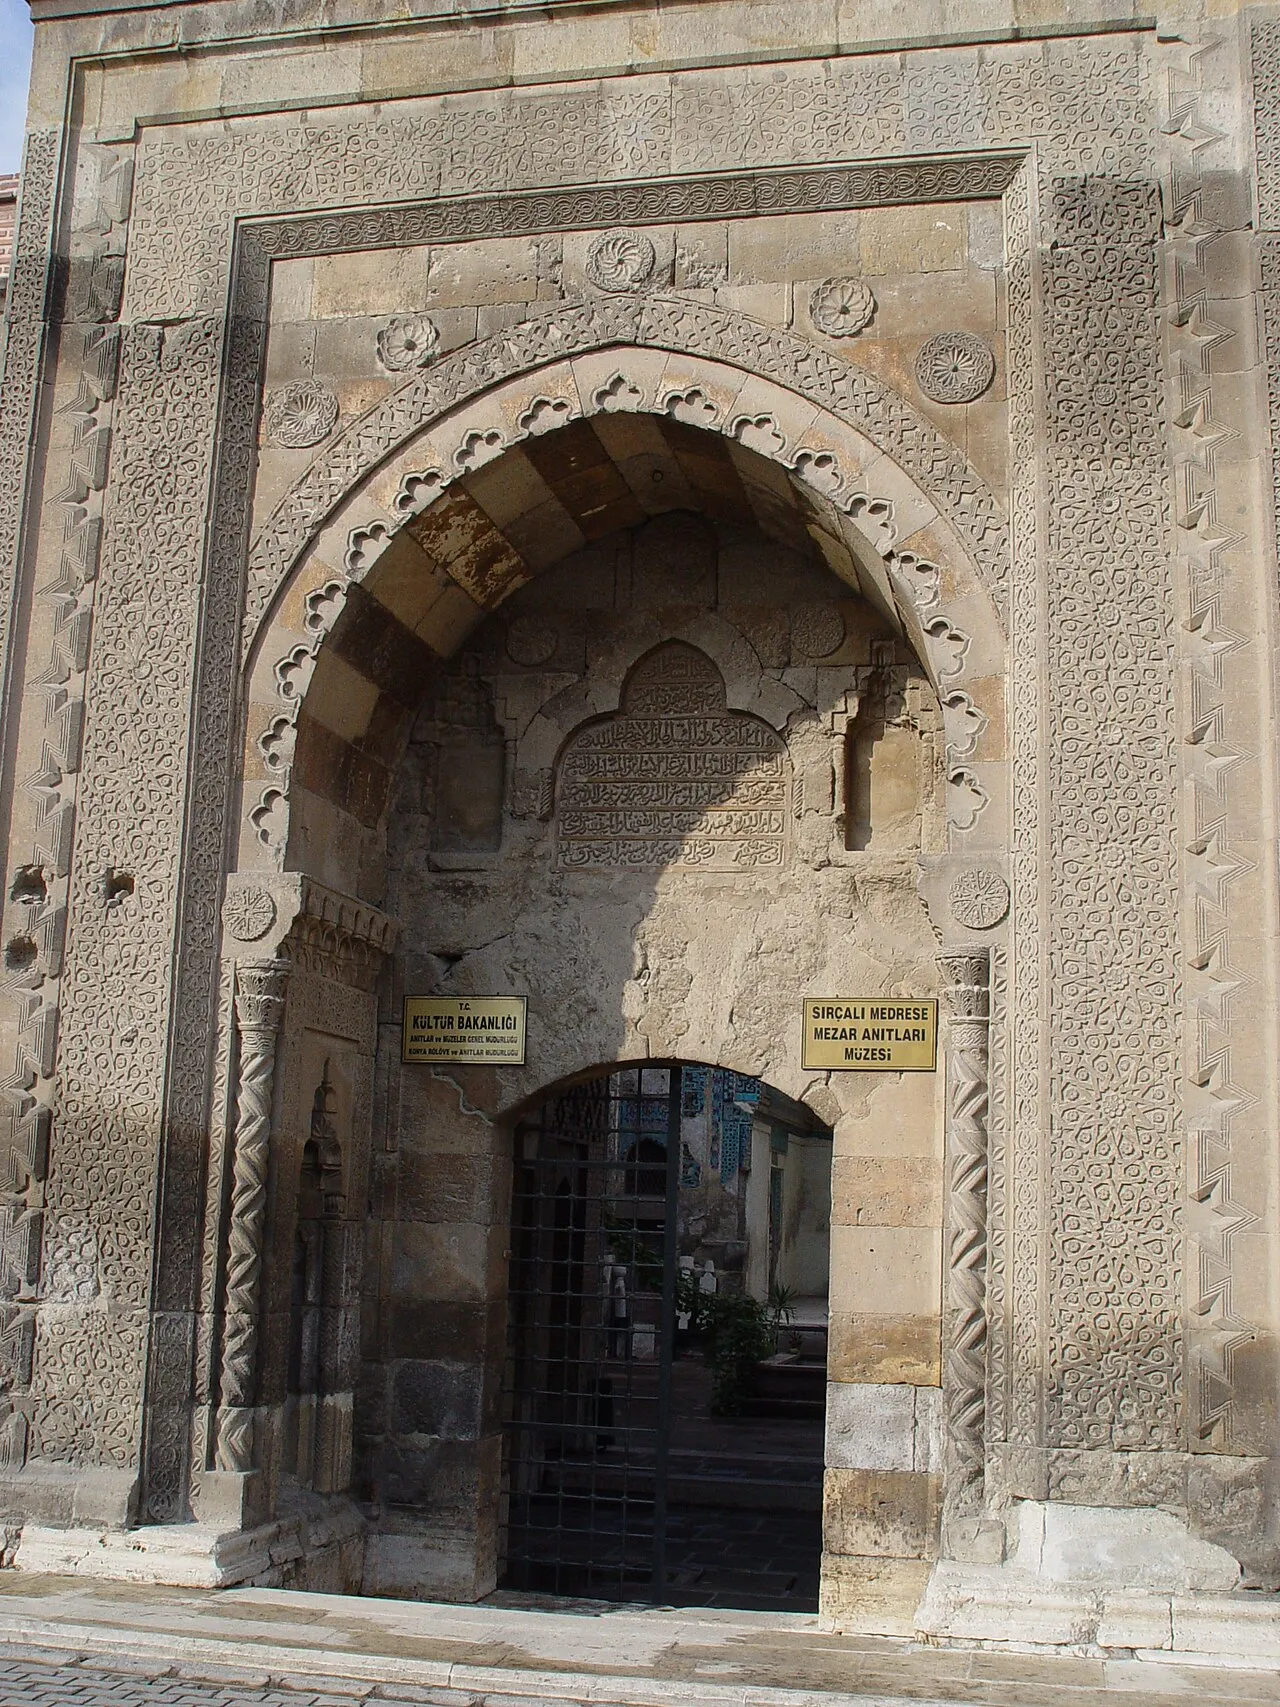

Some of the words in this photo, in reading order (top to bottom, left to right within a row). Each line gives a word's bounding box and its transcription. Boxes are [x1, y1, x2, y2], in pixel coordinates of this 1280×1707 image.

[458, 1003, 471, 1011] T.C.
[812, 1006, 865, 1022] SIRÇALI
[870, 1007, 929, 1021] MEDRESE
[412, 1015, 454, 1030] KÜLTÜR
[457, 1014, 517, 1030] BAKANLIĞI
[814, 1027, 857, 1040] MEZAR
[862, 1028, 926, 1041] ANITLARI
[844, 1047, 892, 1061] MÜZESİ
